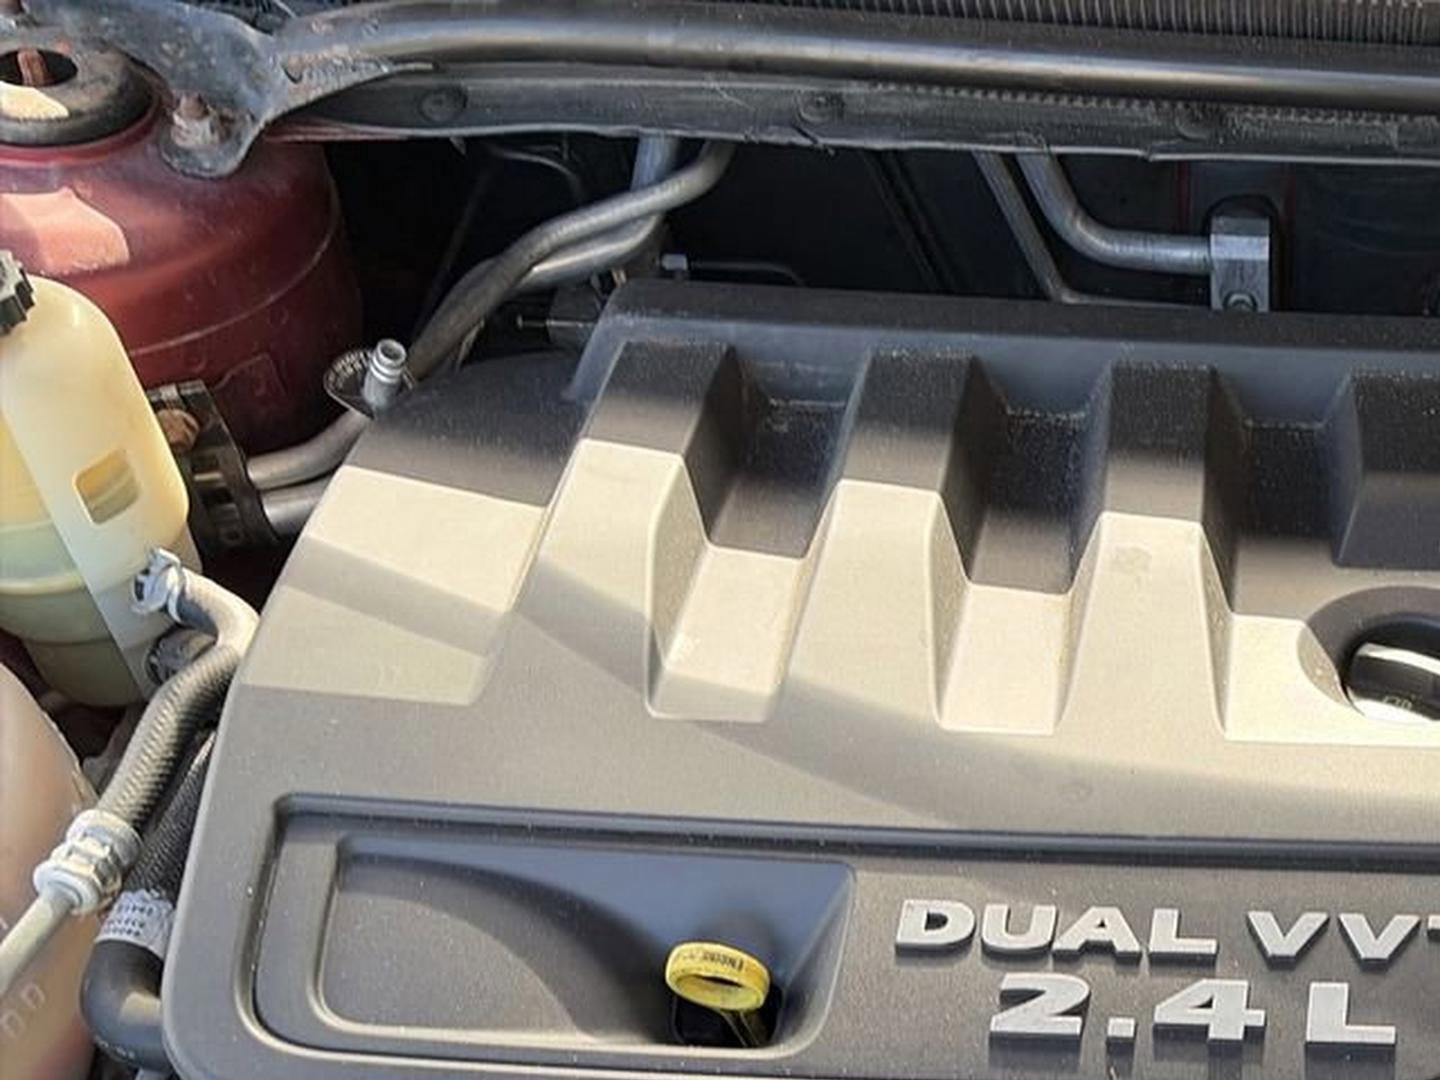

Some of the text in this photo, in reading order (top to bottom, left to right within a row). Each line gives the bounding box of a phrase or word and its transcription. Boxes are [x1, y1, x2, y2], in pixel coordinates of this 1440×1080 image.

[896, 899, 1219, 964] DUAL
[988, 971, 1396, 1045] 2.4 L
